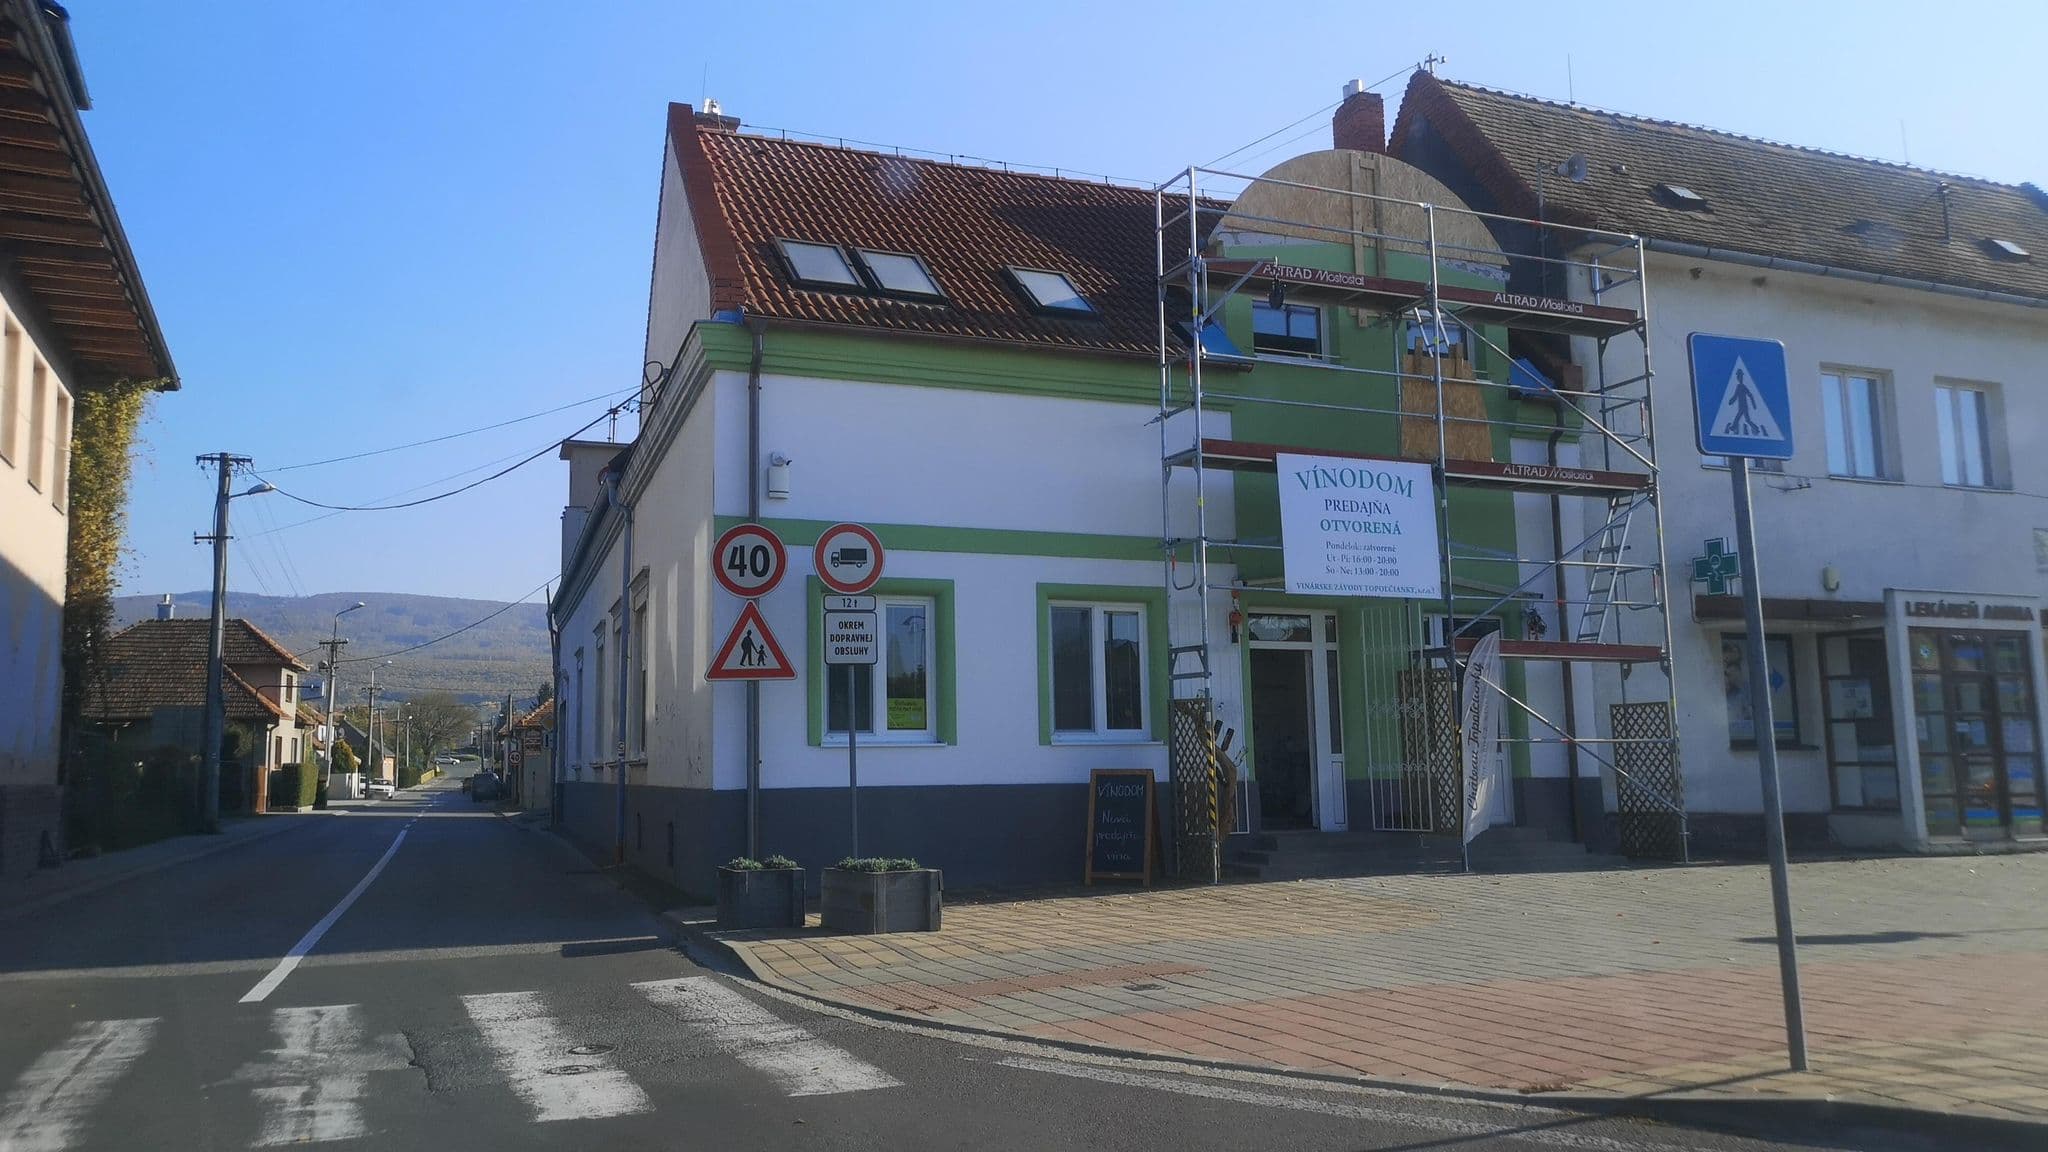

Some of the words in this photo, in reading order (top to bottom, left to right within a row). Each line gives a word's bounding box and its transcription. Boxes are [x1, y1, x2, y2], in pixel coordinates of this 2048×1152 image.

[1315, 270, 1365, 286] Mostostal
[1494, 293, 1538, 307] ALTRAD
[1540, 298, 1584, 313] Mostostal
[1503, 464, 1547, 477] ALTRAD
[1295, 465, 1415, 498] VÍNODOM
[1324, 498, 1391, 517] PREDAJŇA
[1320, 518, 1402, 535] OTVORENÁ
[727, 544, 771, 578] 40
[1377, 555, 1397, 564] 20:00
[1379, 568, 1400, 577] 20:00
[842, 598, 852, 608] 12
[838, 621, 865, 630] OKREM
[830, 634, 873, 643] DOPRAVNEJ
[834, 646, 869, 656] OBSLUHY
